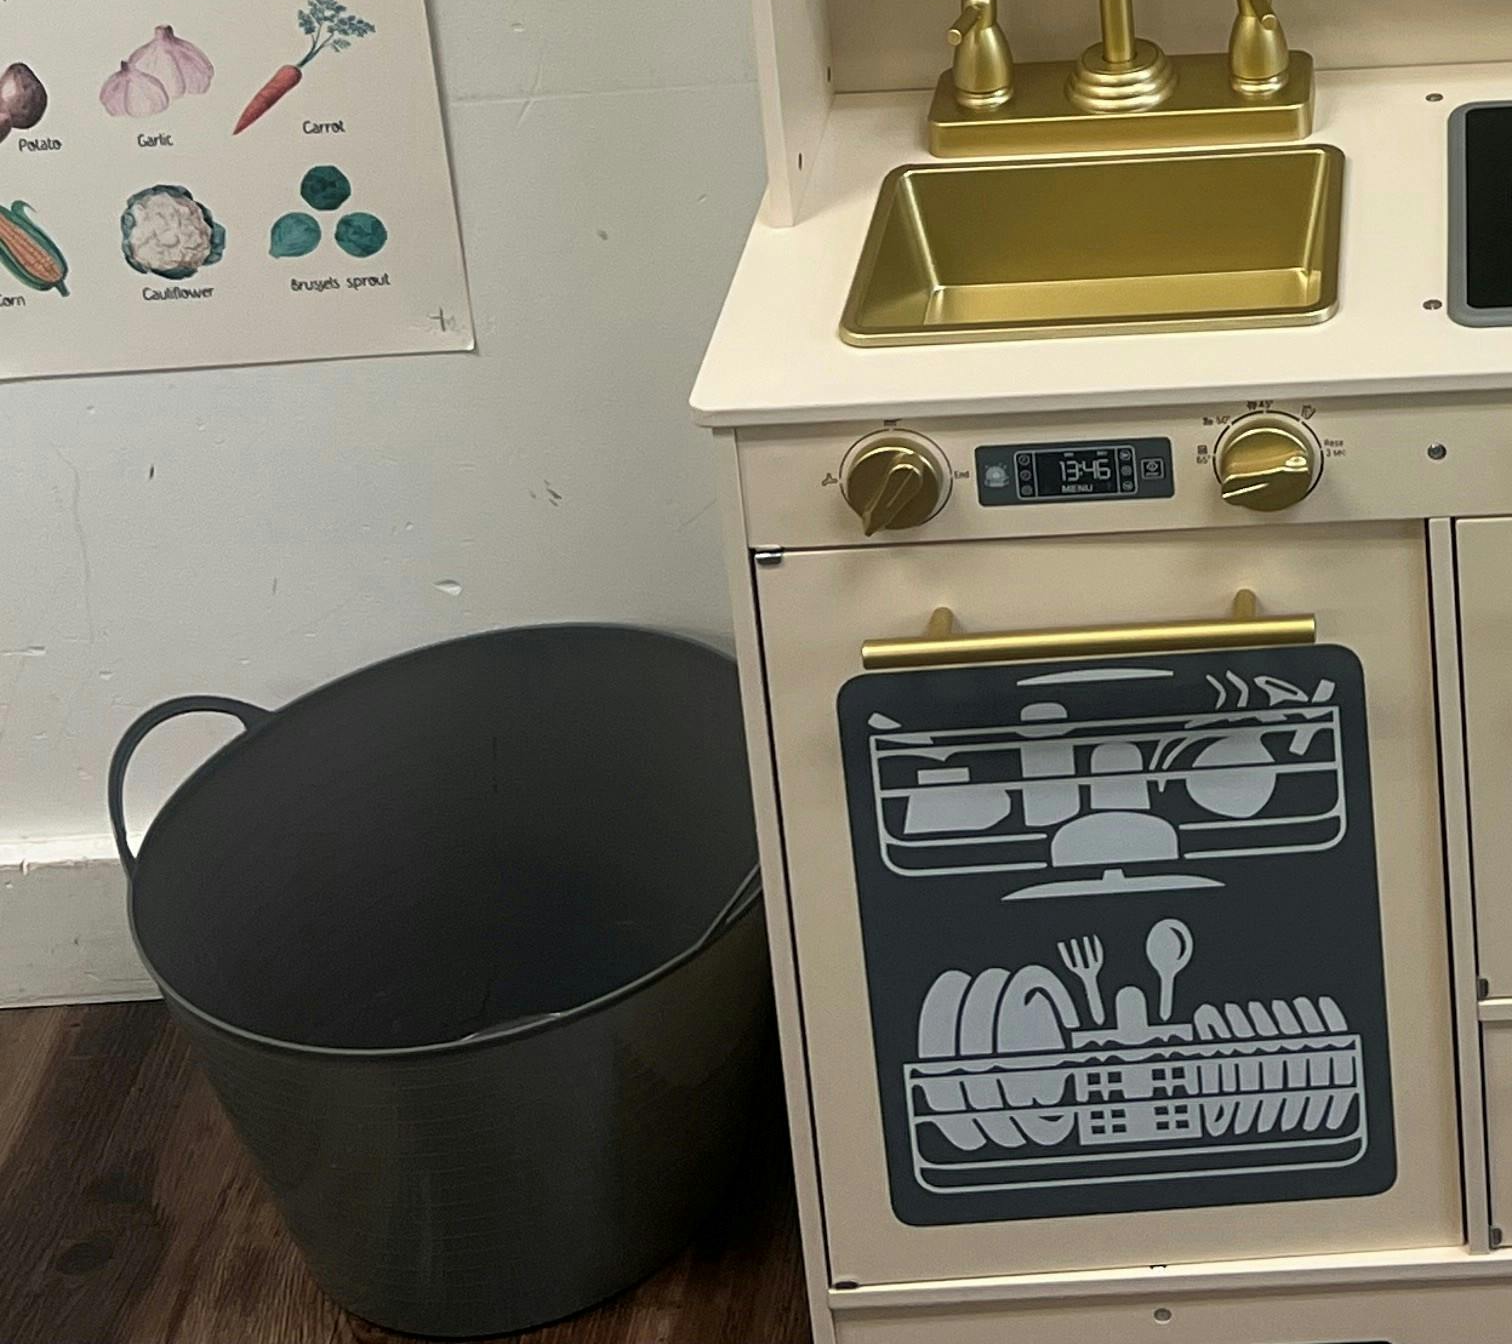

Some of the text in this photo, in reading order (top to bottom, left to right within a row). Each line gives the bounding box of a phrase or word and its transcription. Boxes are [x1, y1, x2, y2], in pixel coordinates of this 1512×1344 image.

[302, 119, 345, 135] Carrot
[18, 137, 62, 153] Potato
[137, 133, 173, 148] Garlic
[290, 272, 391, 292] Brussels sprout
[142, 286, 214, 301] Cauliflower
[1059, 459, 1111, 482] 13:46
